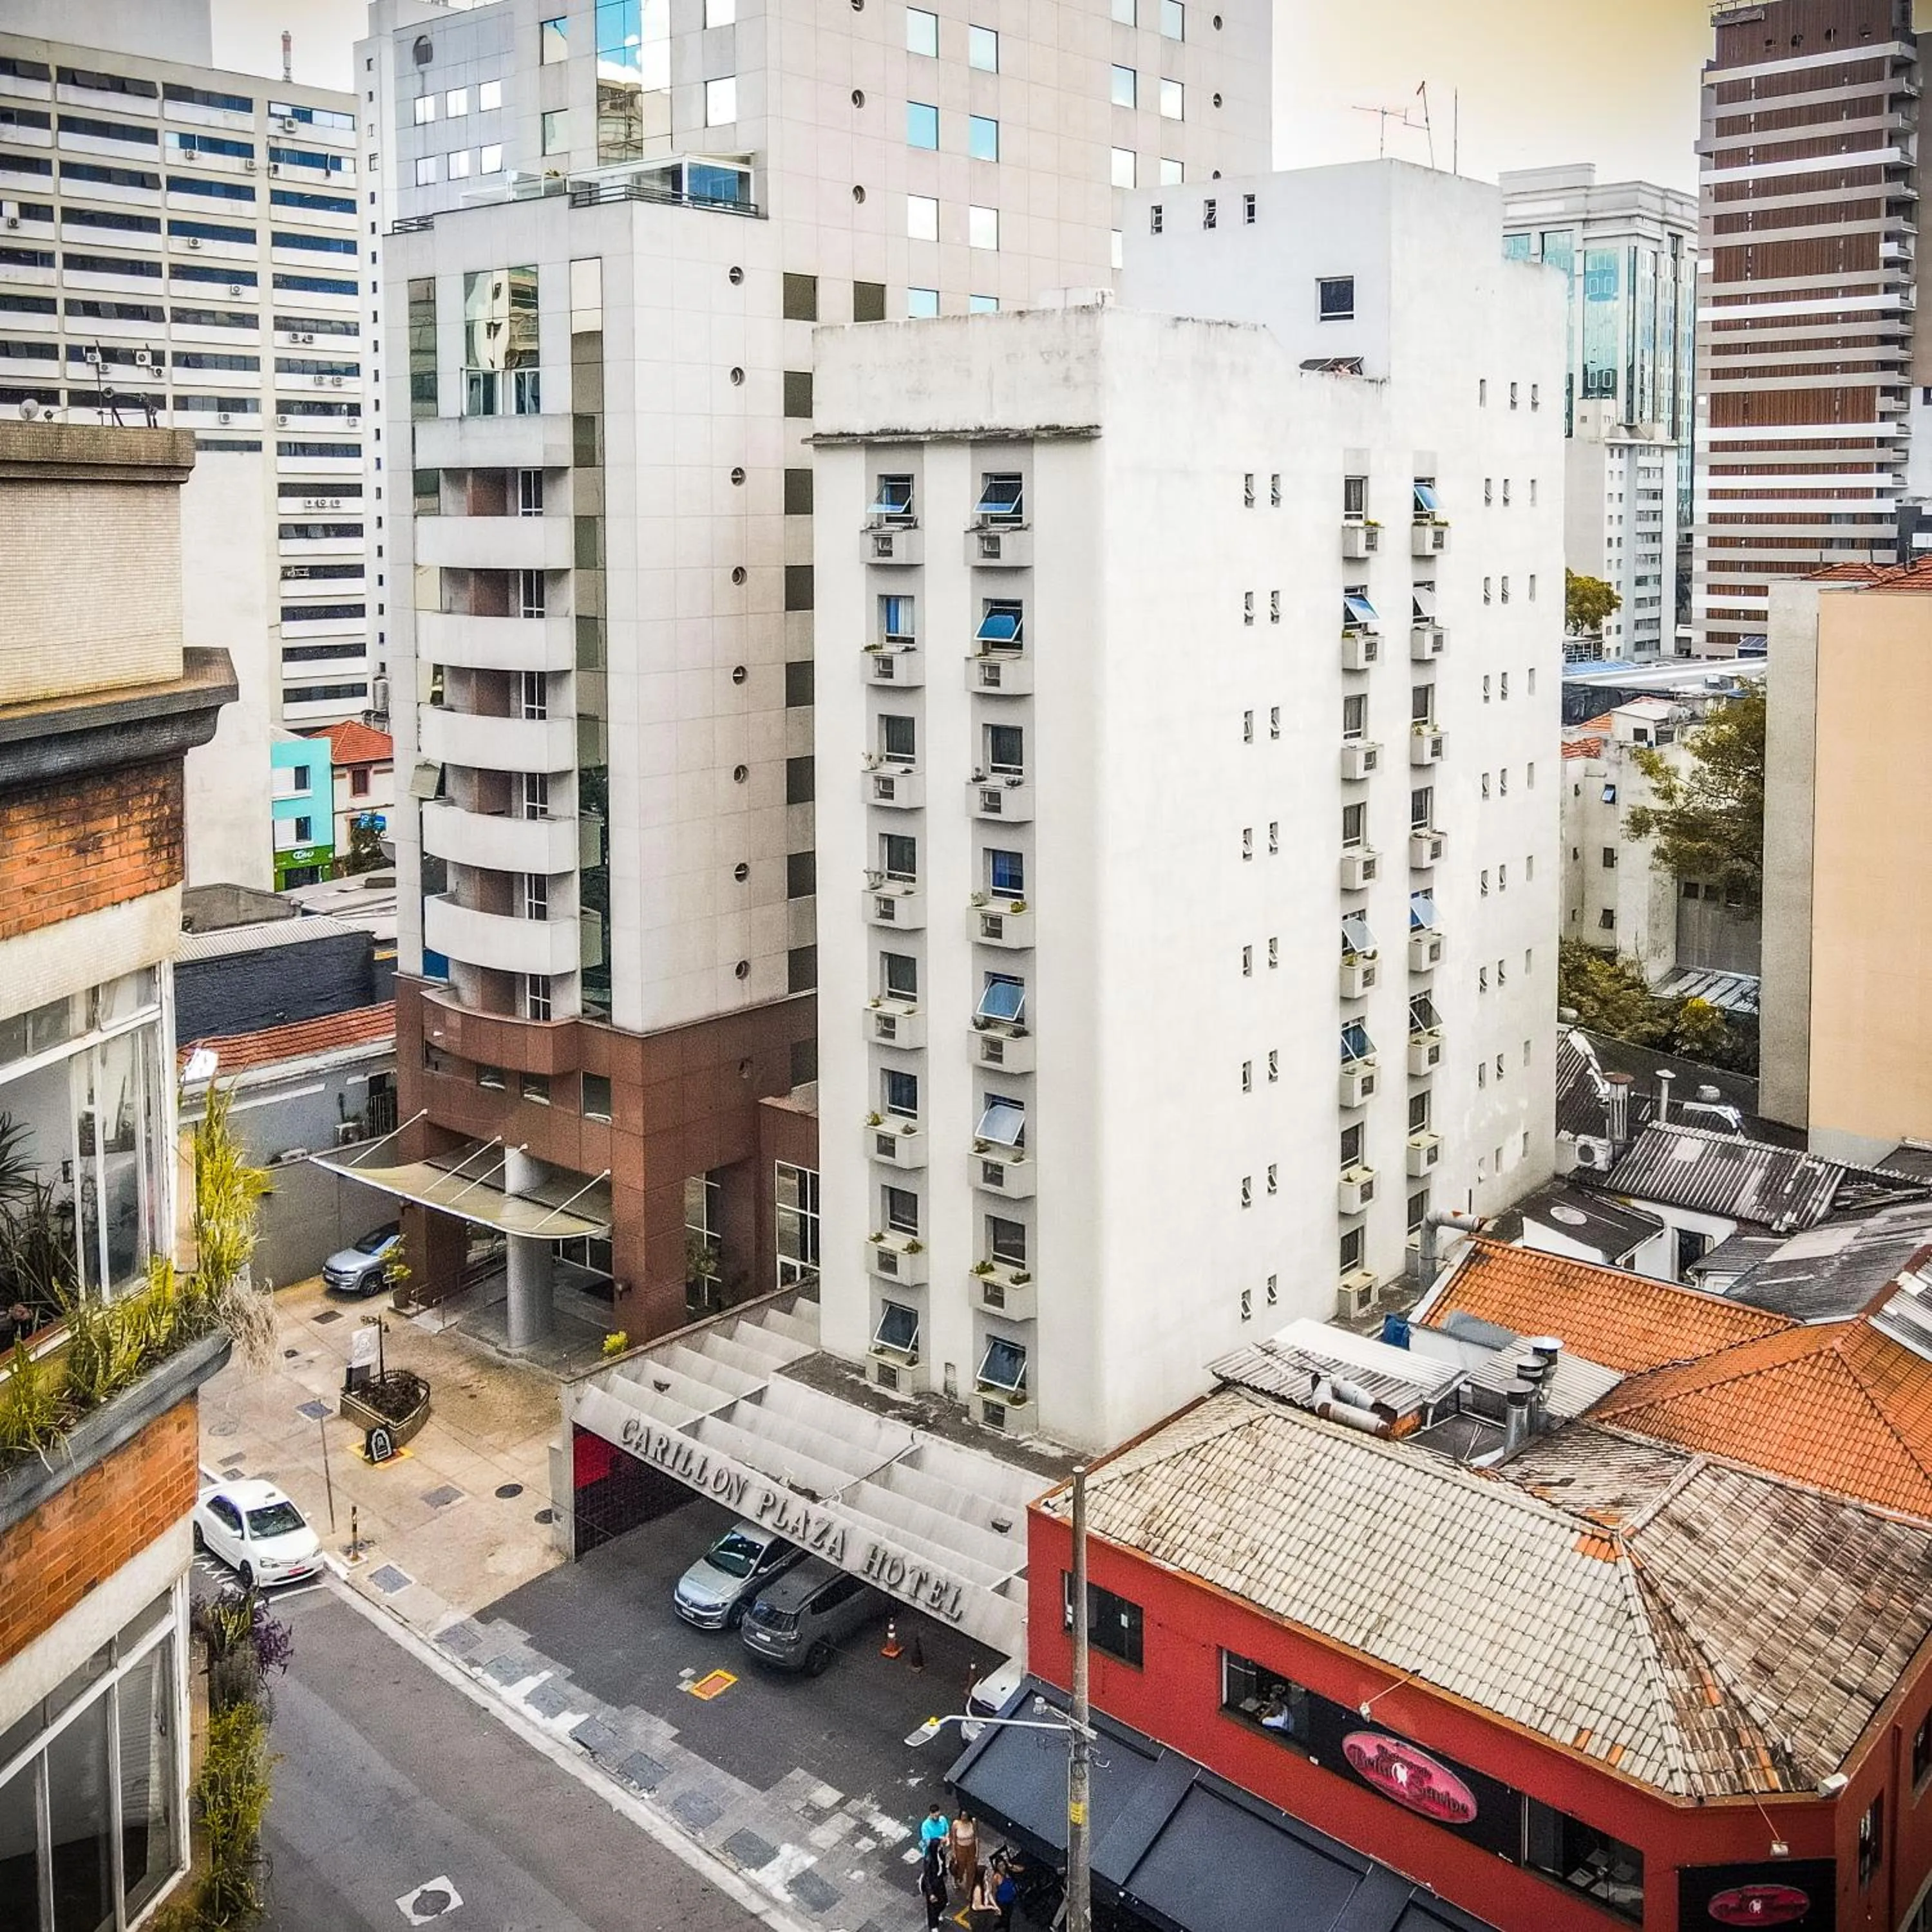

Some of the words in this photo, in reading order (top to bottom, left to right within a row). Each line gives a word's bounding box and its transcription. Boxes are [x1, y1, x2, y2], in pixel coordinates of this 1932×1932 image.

[621, 1419, 749, 1506] CARILLON
[755, 1491, 847, 1563] PLAZA
[863, 1544, 963, 1622] HOTEL
